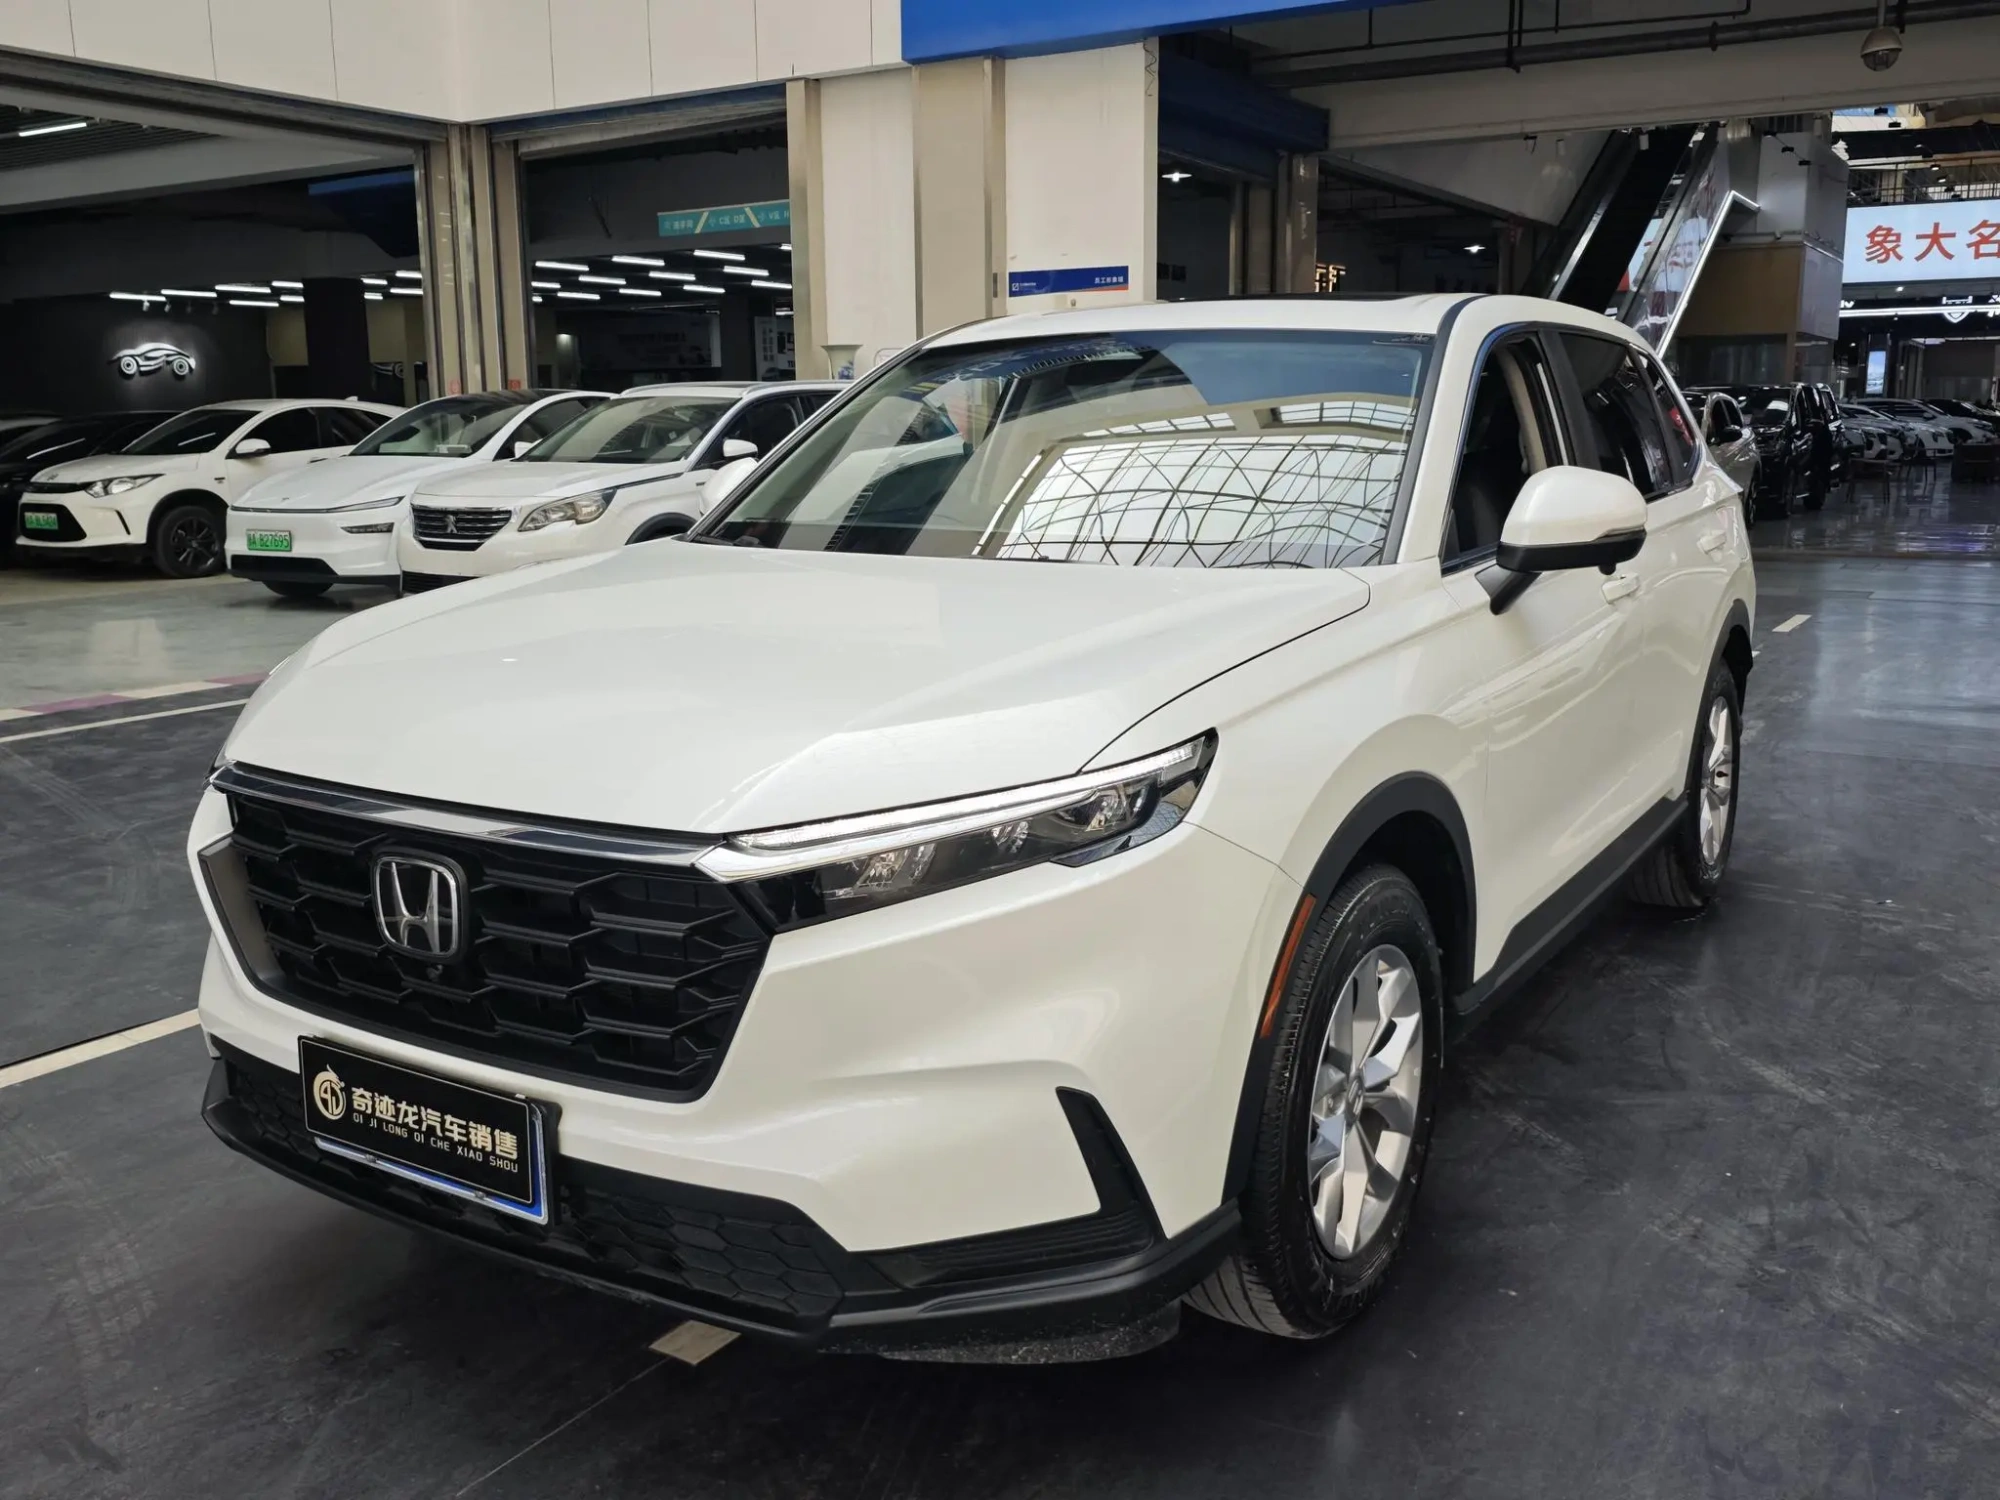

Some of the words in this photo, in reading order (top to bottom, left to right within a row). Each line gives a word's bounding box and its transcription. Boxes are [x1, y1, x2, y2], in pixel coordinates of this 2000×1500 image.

[1865, 219, 2000, 264] 象大名
[351, 1086, 518, 1160] 奇迹龙汽车销售
[369, 1117, 377, 1128] JI
[382, 1121, 408, 1138] LONG
[430, 1137, 450, 1152] CHE
[457, 1145, 483, 1162] XIAO
[489, 1155, 518, 1173] SHOU
